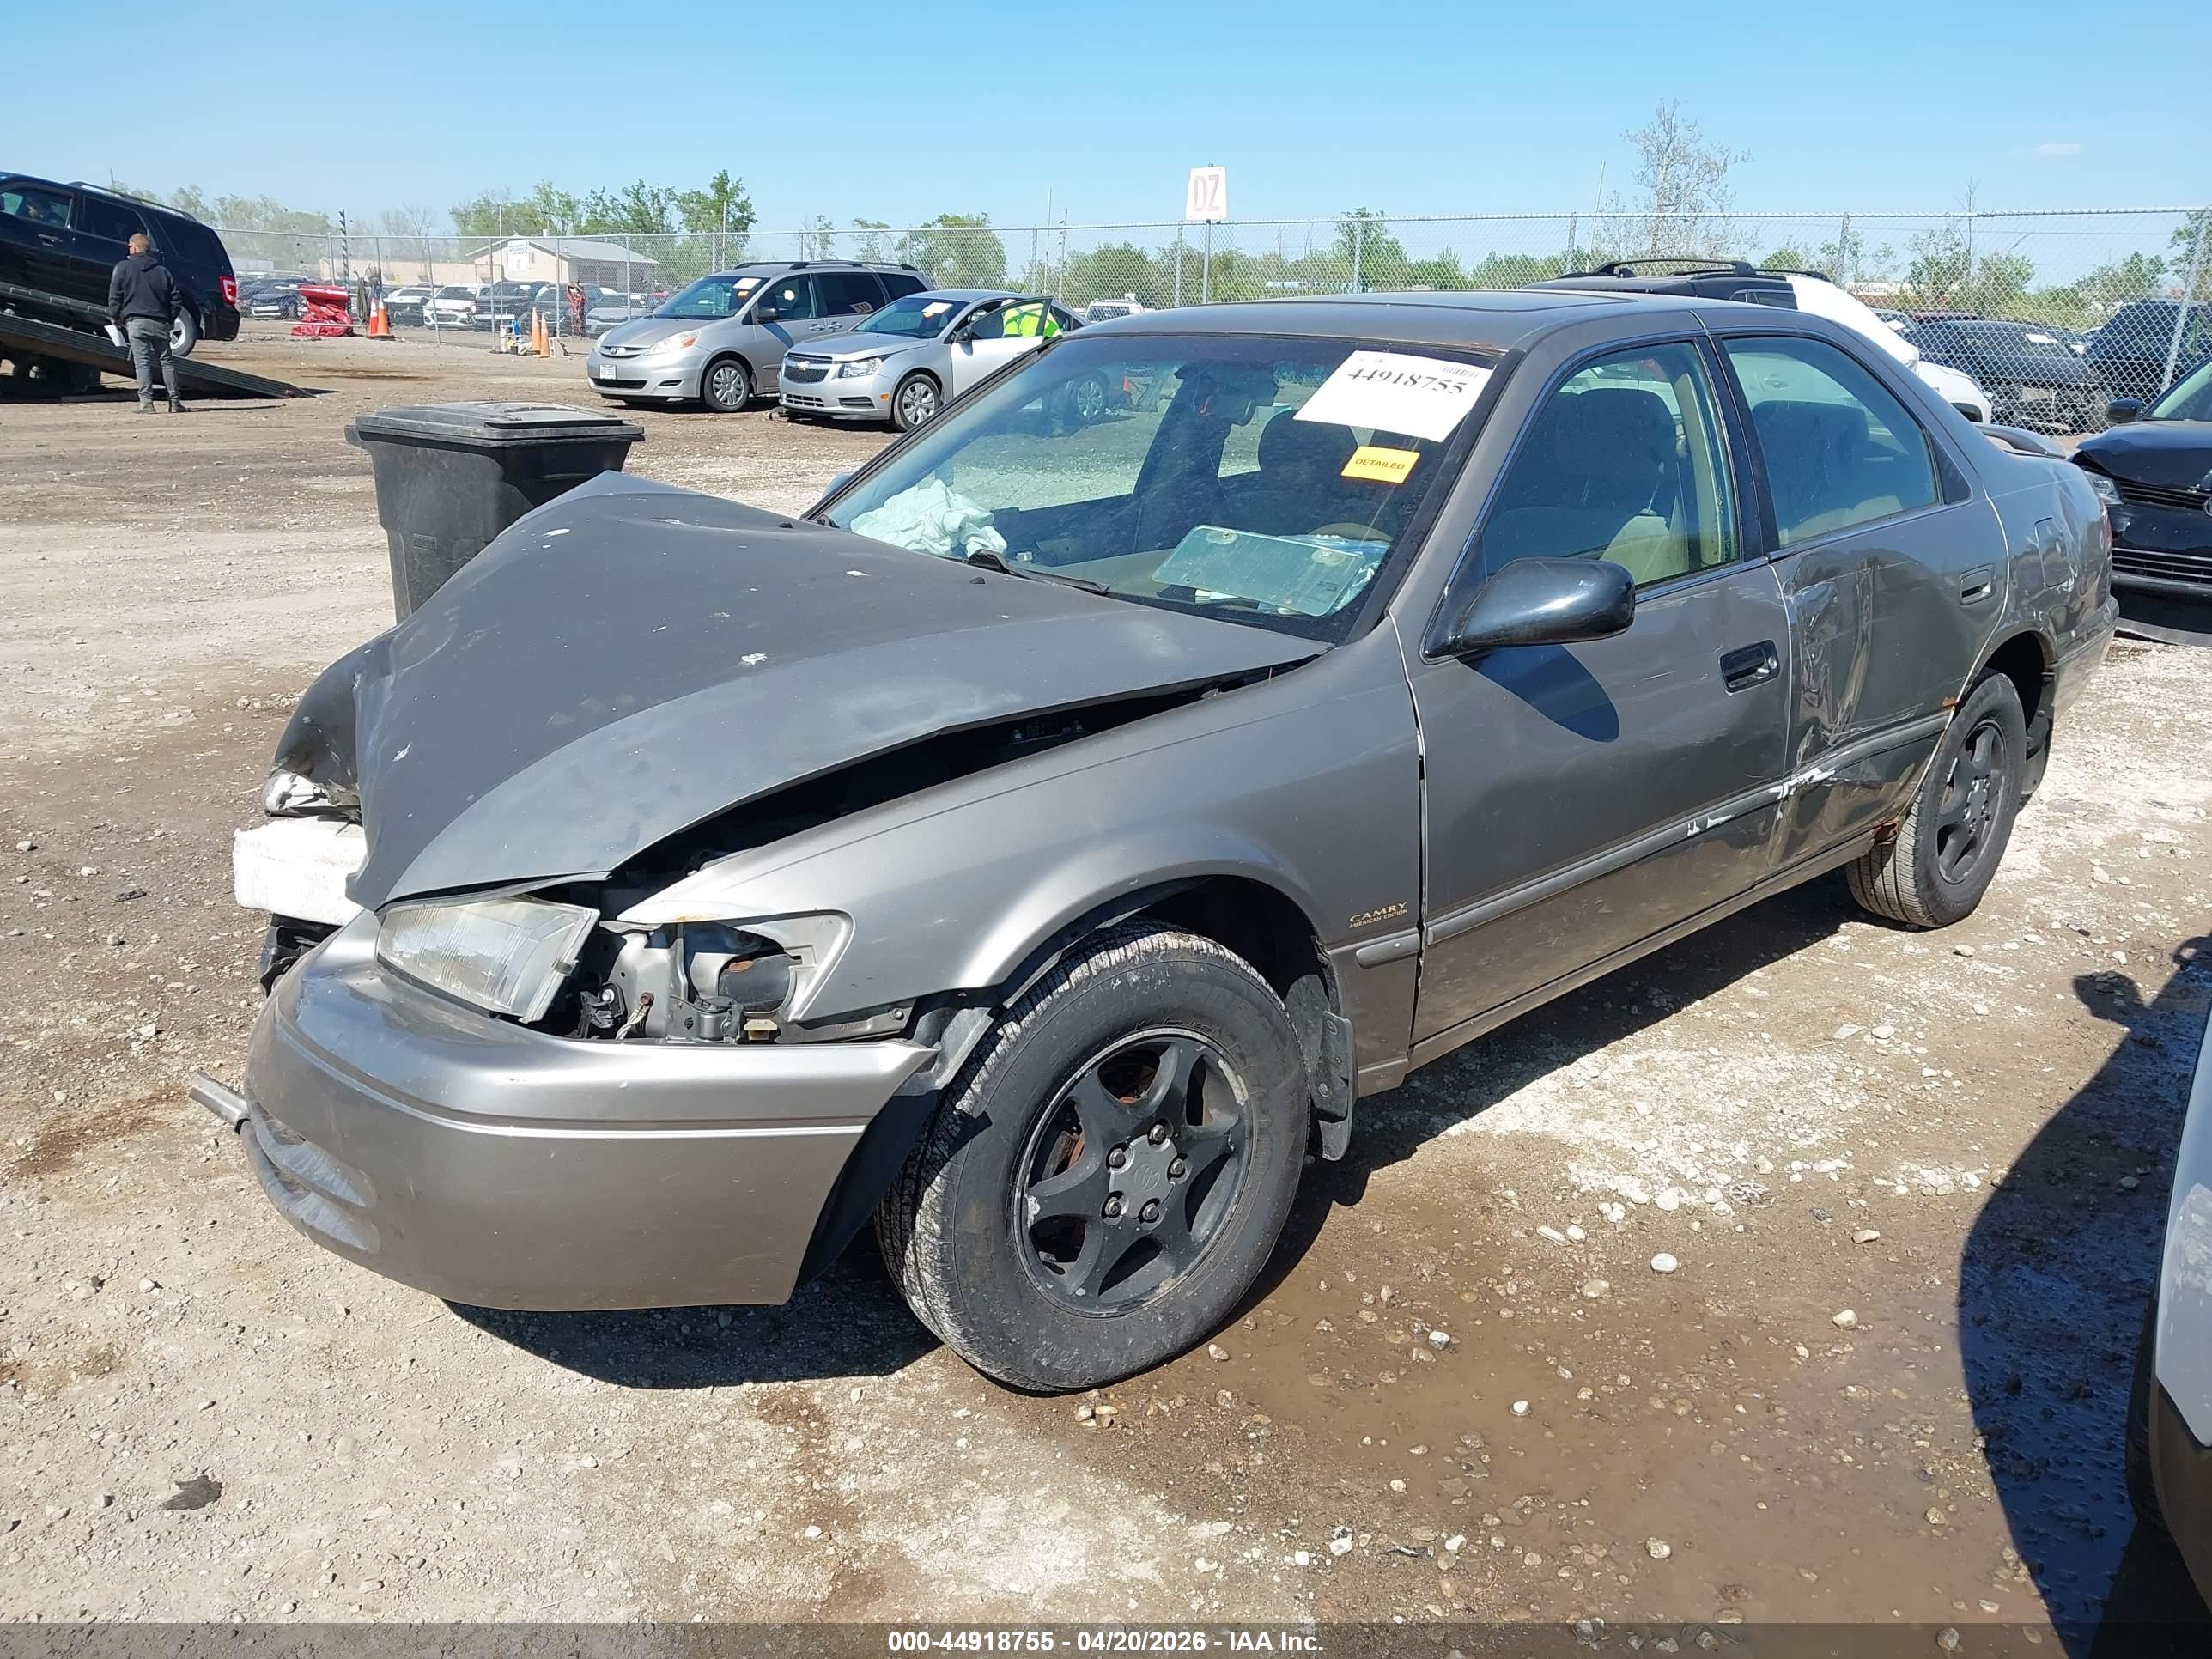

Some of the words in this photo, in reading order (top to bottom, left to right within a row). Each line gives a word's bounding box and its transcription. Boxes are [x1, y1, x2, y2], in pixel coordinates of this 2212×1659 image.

[1194, 174, 1220, 212] DZ
[1347, 368, 1468, 395] 44918755
[1354, 459, 1406, 471] DETAILED
[1348, 915, 1382, 928] AMERICAN
[1383, 907, 1408, 920] EDITION
[1349, 901, 1407, 922] CAMRY
